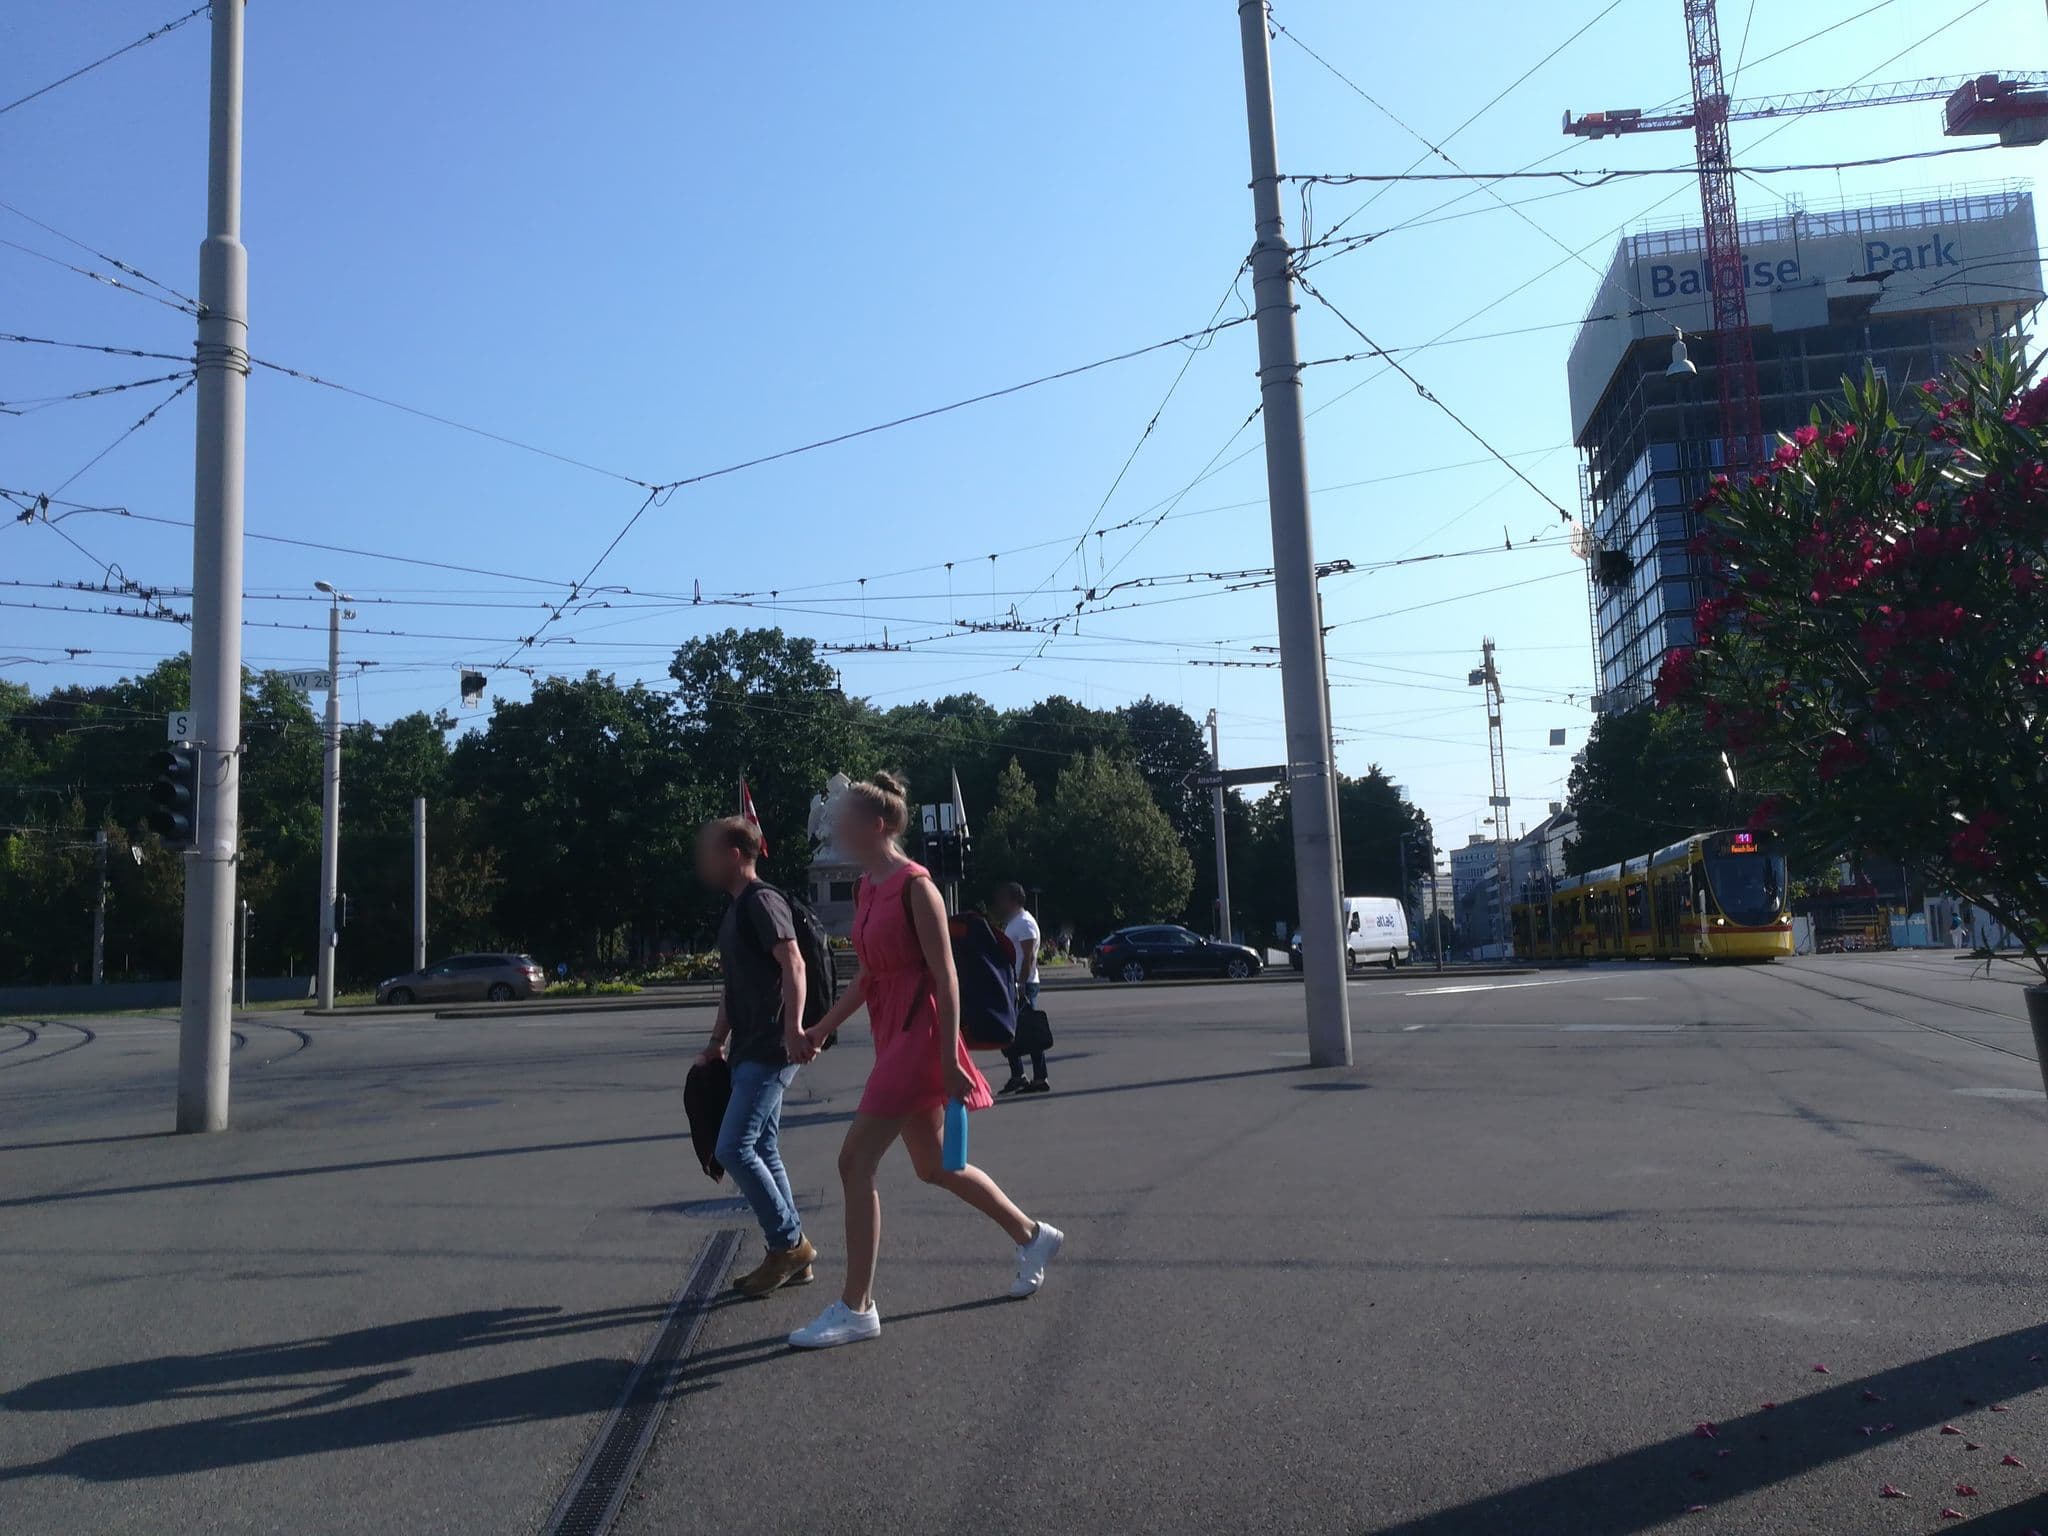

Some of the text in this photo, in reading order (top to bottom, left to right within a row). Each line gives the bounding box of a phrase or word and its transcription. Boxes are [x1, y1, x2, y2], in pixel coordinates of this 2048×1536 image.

[1864, 233, 1959, 273] Park
[293, 674, 332, 688] W 25
[176, 716, 188, 735] S
